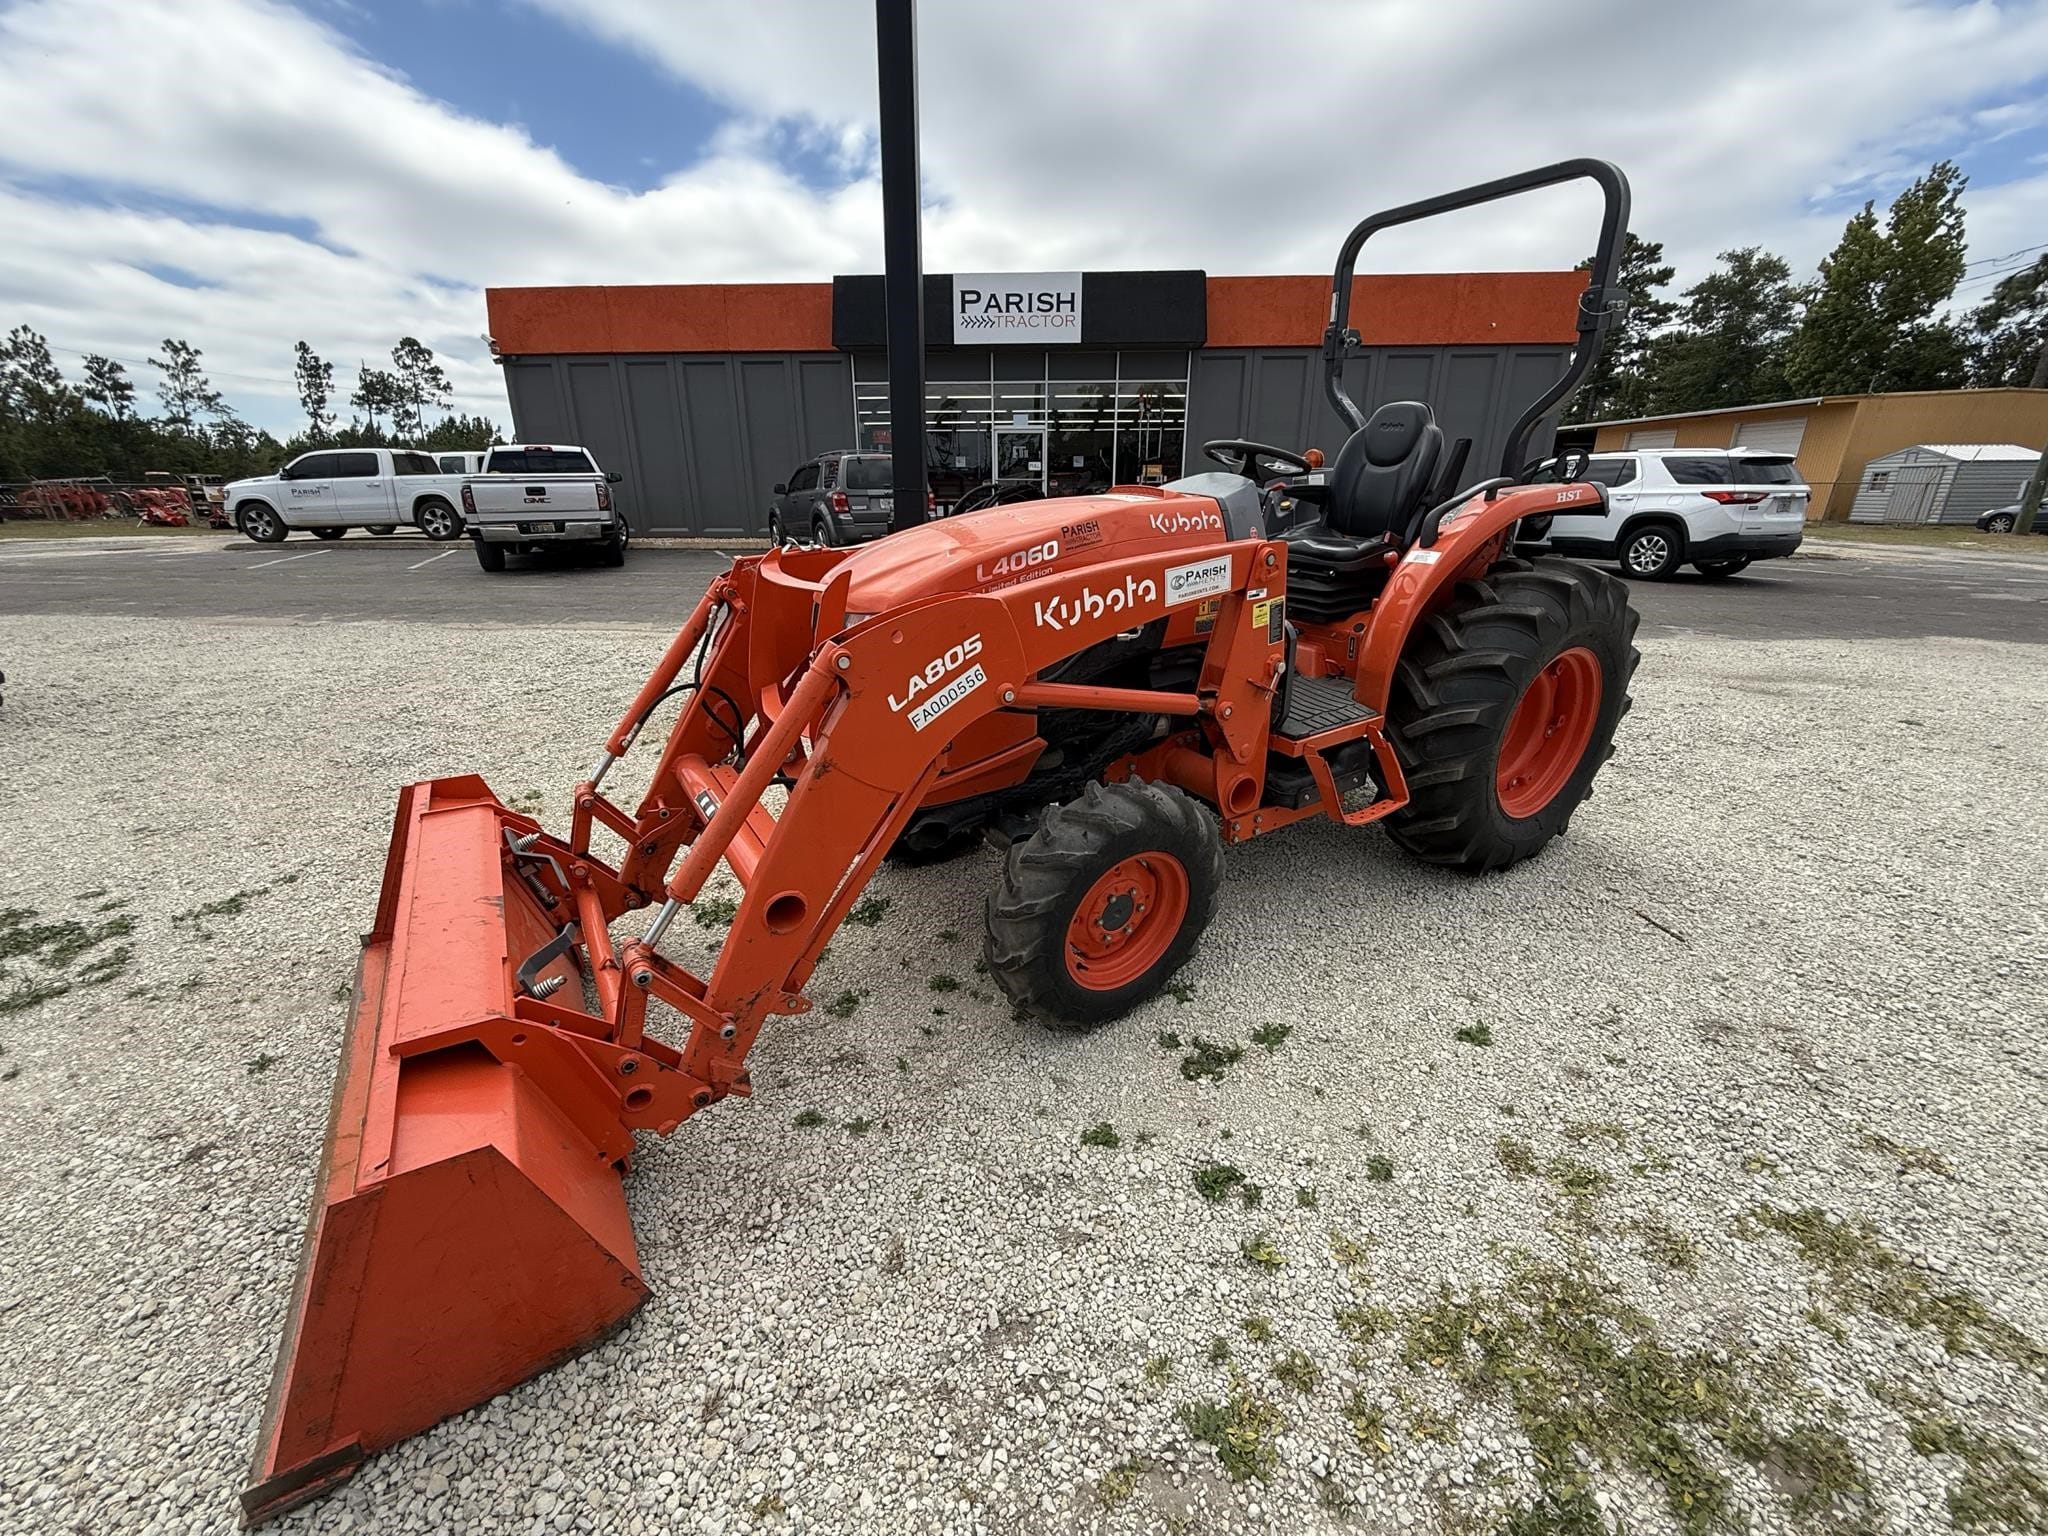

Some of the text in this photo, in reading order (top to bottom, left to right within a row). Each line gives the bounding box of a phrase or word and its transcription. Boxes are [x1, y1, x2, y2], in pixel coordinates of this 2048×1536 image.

[959, 290, 1076, 314] PARISH
[994, 314, 1076, 328] TRACTOR
[1556, 489, 1582, 503] HST
[1061, 520, 1100, 539] PARISH
[1149, 510, 1222, 534] Kubota
[976, 540, 1059, 583] L4060
[1185, 564, 1227, 582] PARISH
[1020, 566, 1053, 583] Edition
[1034, 575, 1157, 631] Kubota
[887, 633, 983, 712] LA805
[911, 668, 984, 728] FA000556
